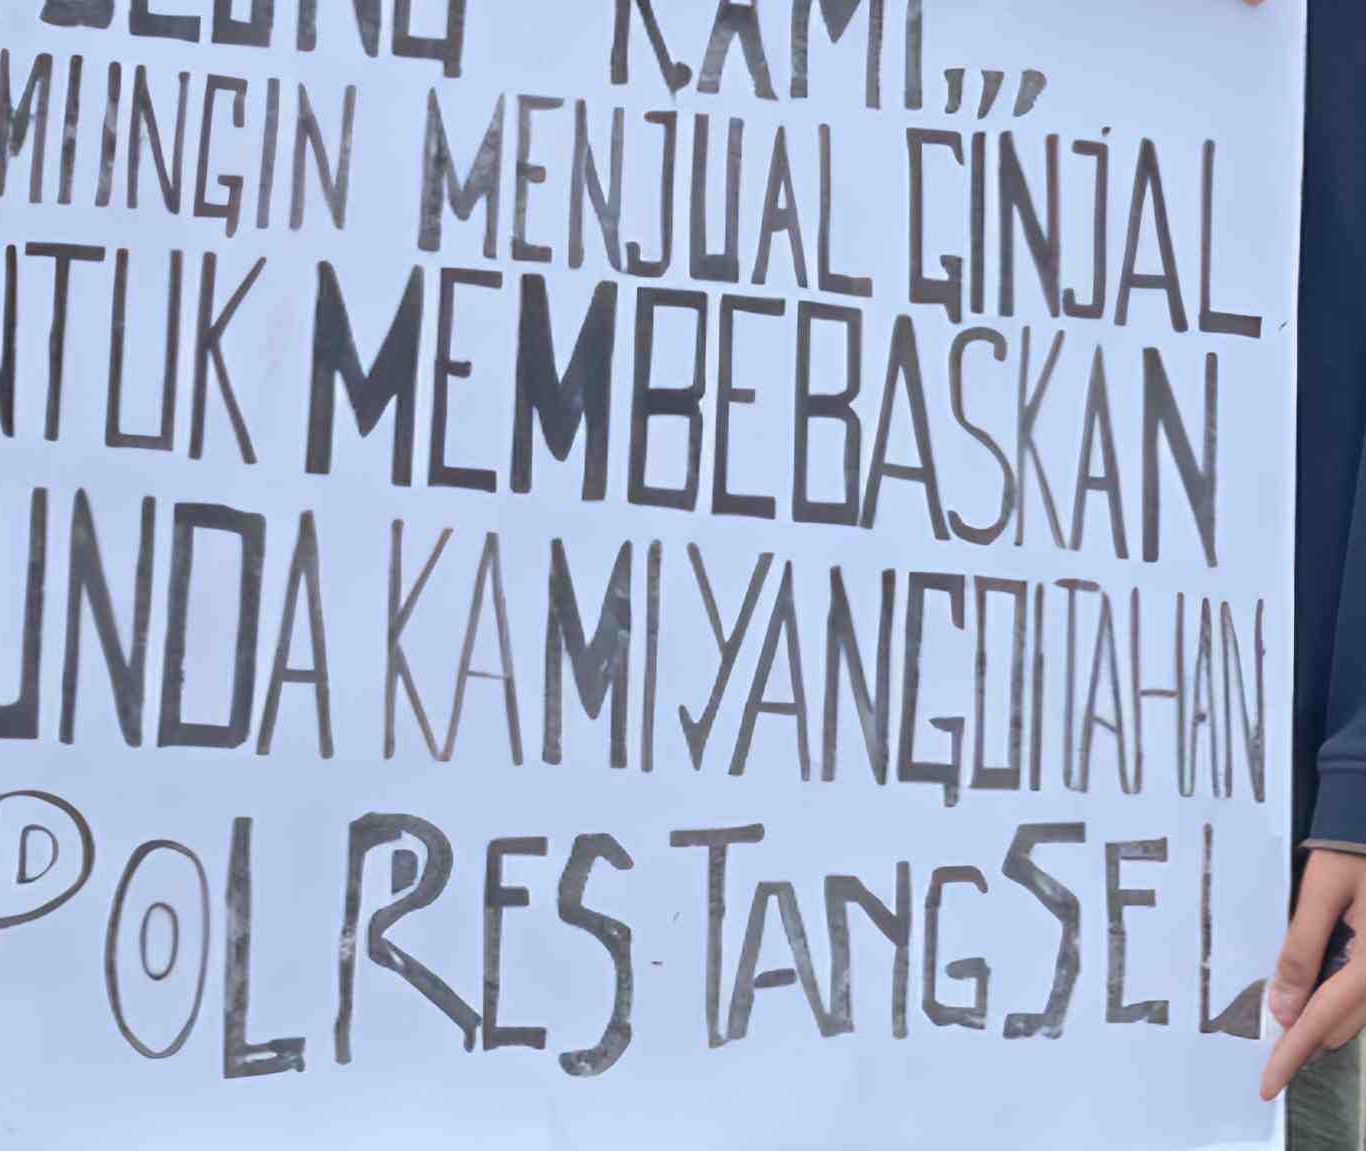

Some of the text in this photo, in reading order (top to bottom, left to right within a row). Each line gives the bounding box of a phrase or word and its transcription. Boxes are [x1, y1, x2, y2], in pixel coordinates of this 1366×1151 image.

[418, 87, 872, 297] MENJUAL
[906, 126, 1262, 338] GINJAL
[306, 260, 1217, 567] MEMBEBASKAN
[669, 822, 1269, 1048] TANGSEL
